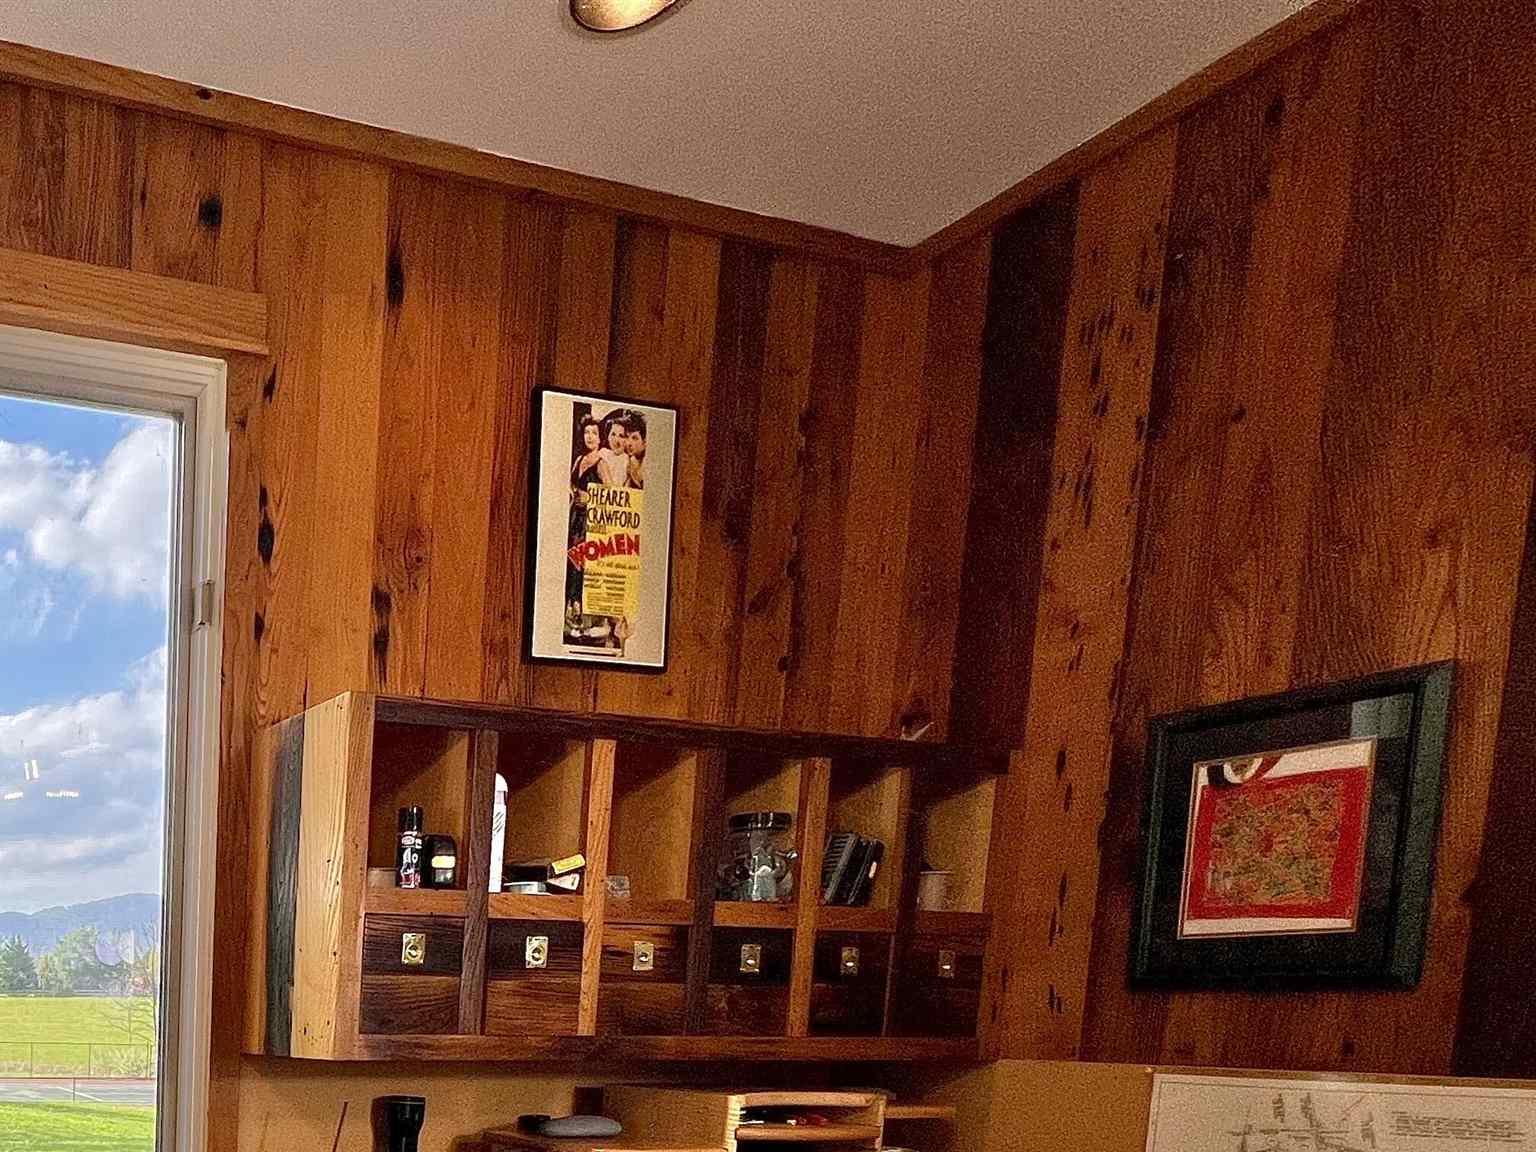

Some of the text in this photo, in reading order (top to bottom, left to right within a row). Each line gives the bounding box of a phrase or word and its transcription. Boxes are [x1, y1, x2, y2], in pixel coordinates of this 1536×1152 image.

[587, 487, 632, 508] SHEARER
[587, 507, 641, 529] CRAWFORD
[567, 533, 641, 570] WOMEN
